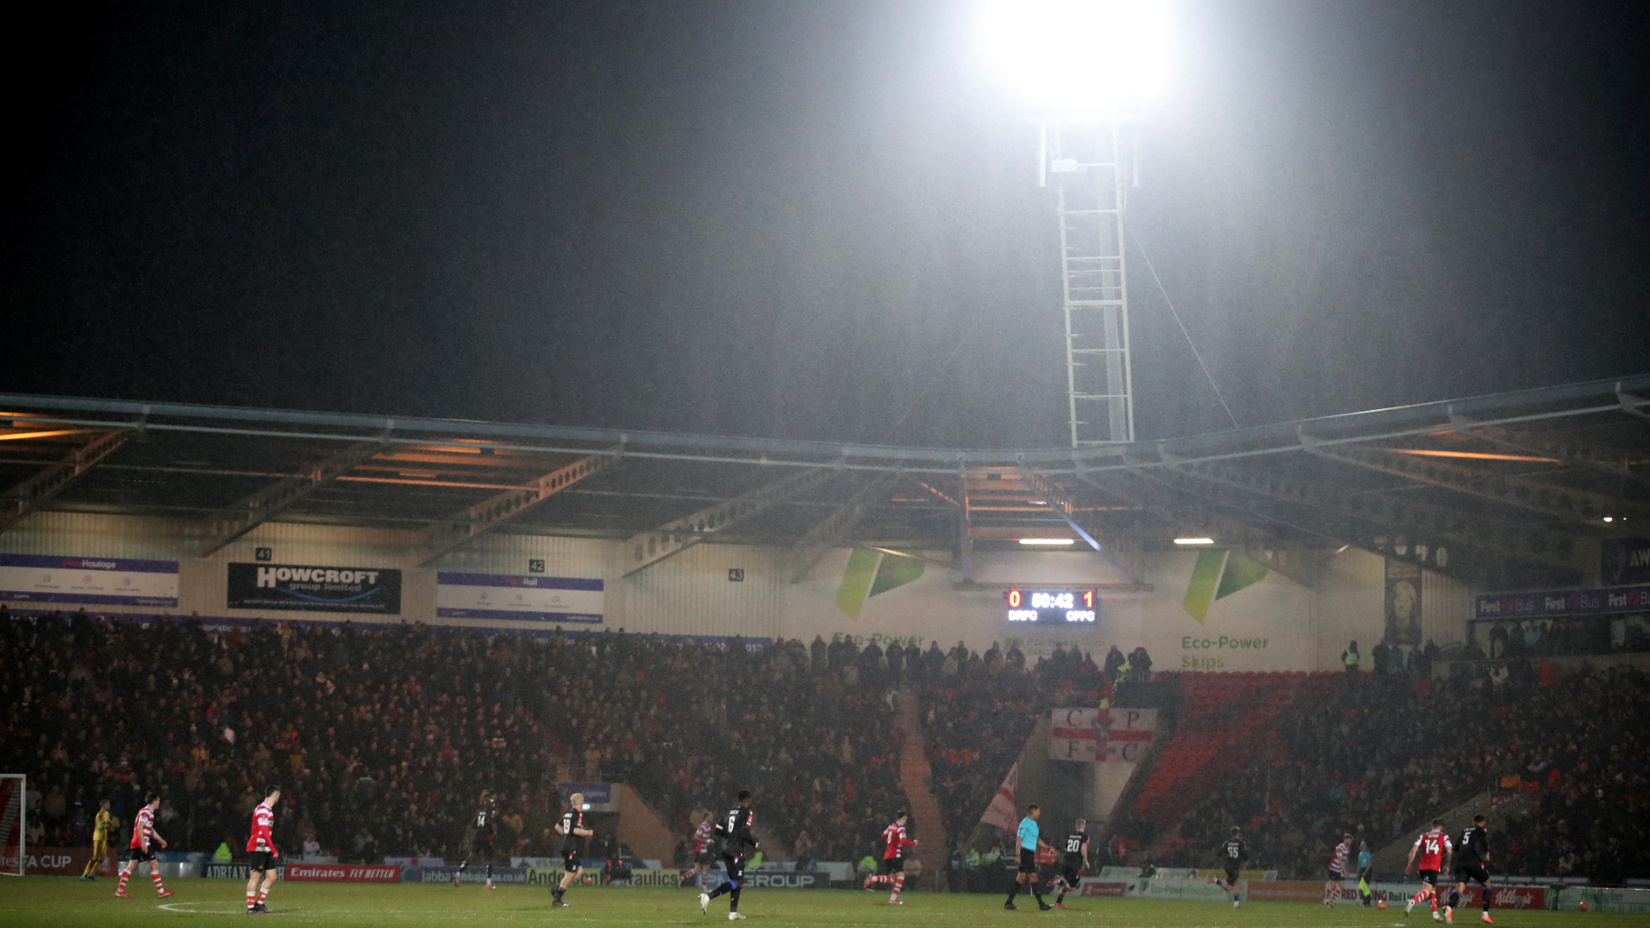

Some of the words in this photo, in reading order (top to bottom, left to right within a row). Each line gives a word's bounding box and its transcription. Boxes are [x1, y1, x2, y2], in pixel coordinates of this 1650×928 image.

[258, 549, 270, 559] 41
[531, 561, 544, 571] 42
[257, 567, 379, 588] HOWCROFT
[730, 570, 743, 580] 43
[289, 583, 321, 592] group
[324, 582, 362, 592] limited
[1009, 589, 1021, 608] 0
[1083, 590, 1093, 609] 1
[1480, 600, 1500, 612] First
[1545, 596, 1565, 610] First
[1580, 595, 1599, 609] Bus
[1609, 593, 1627, 606] First
[1181, 635, 1269, 649] Eco-Power
[1066, 709, 1082, 726] C
[1127, 711, 1140, 728] P
[1067, 741, 1080, 758] F
[1122, 743, 1137, 760] C
[728, 815, 736, 833] 6
[1462, 831, 1471, 845] 5
[1067, 839, 1080, 852] 20
[1227, 846, 1239, 858] 55
[1424, 839, 1440, 854] 14
[41, 854, 72, 868] CUP
[206, 865, 247, 879] ADRIAN
[290, 867, 345, 878] Emirates
[350, 866, 364, 878] FLY
[366, 866, 394, 878] BETTER
[743, 874, 815, 887] GROUP
[1341, 888, 1357, 900] RED
[1495, 888, 1532, 909] Kellogg's
